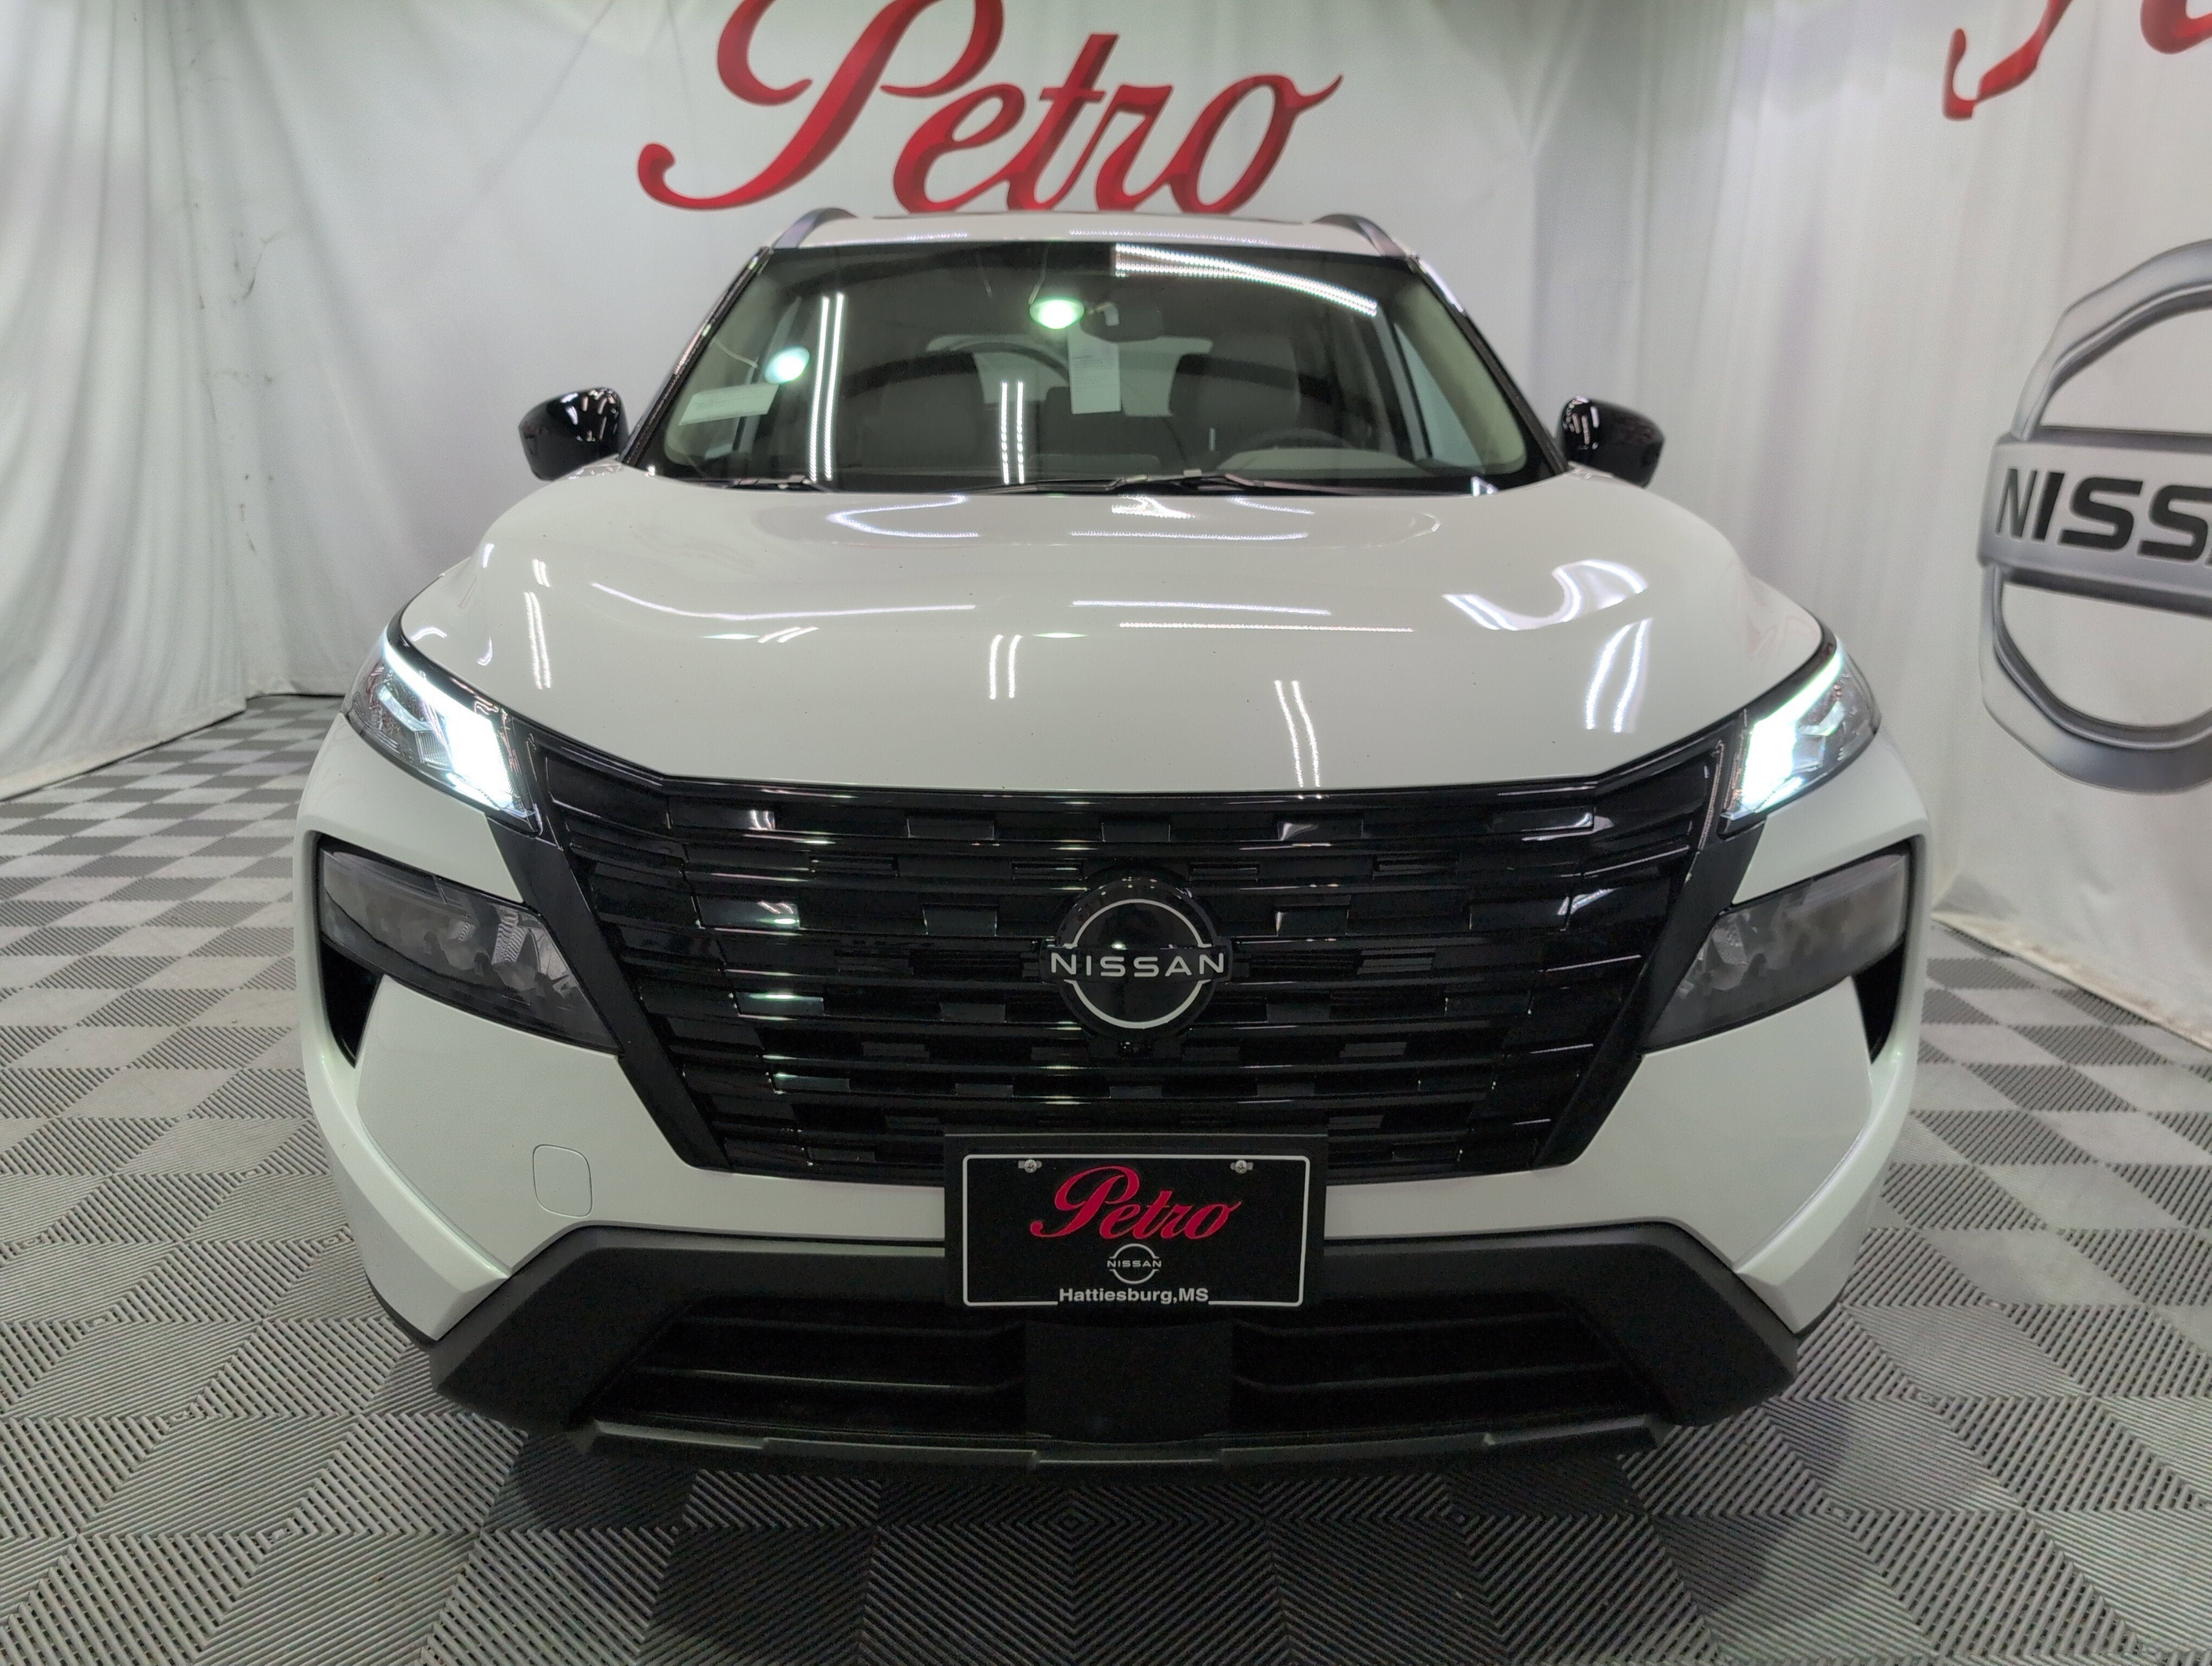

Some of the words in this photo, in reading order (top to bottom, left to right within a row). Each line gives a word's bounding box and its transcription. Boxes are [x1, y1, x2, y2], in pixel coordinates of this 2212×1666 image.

[637, 0, 1343, 215] Petro
[1995, 467, 2212, 568] NISS
[1051, 952, 1224, 977] NISSAN
[1030, 1165, 1242, 1239] Petro
[1107, 1259, 1162, 1268] NISSAN
